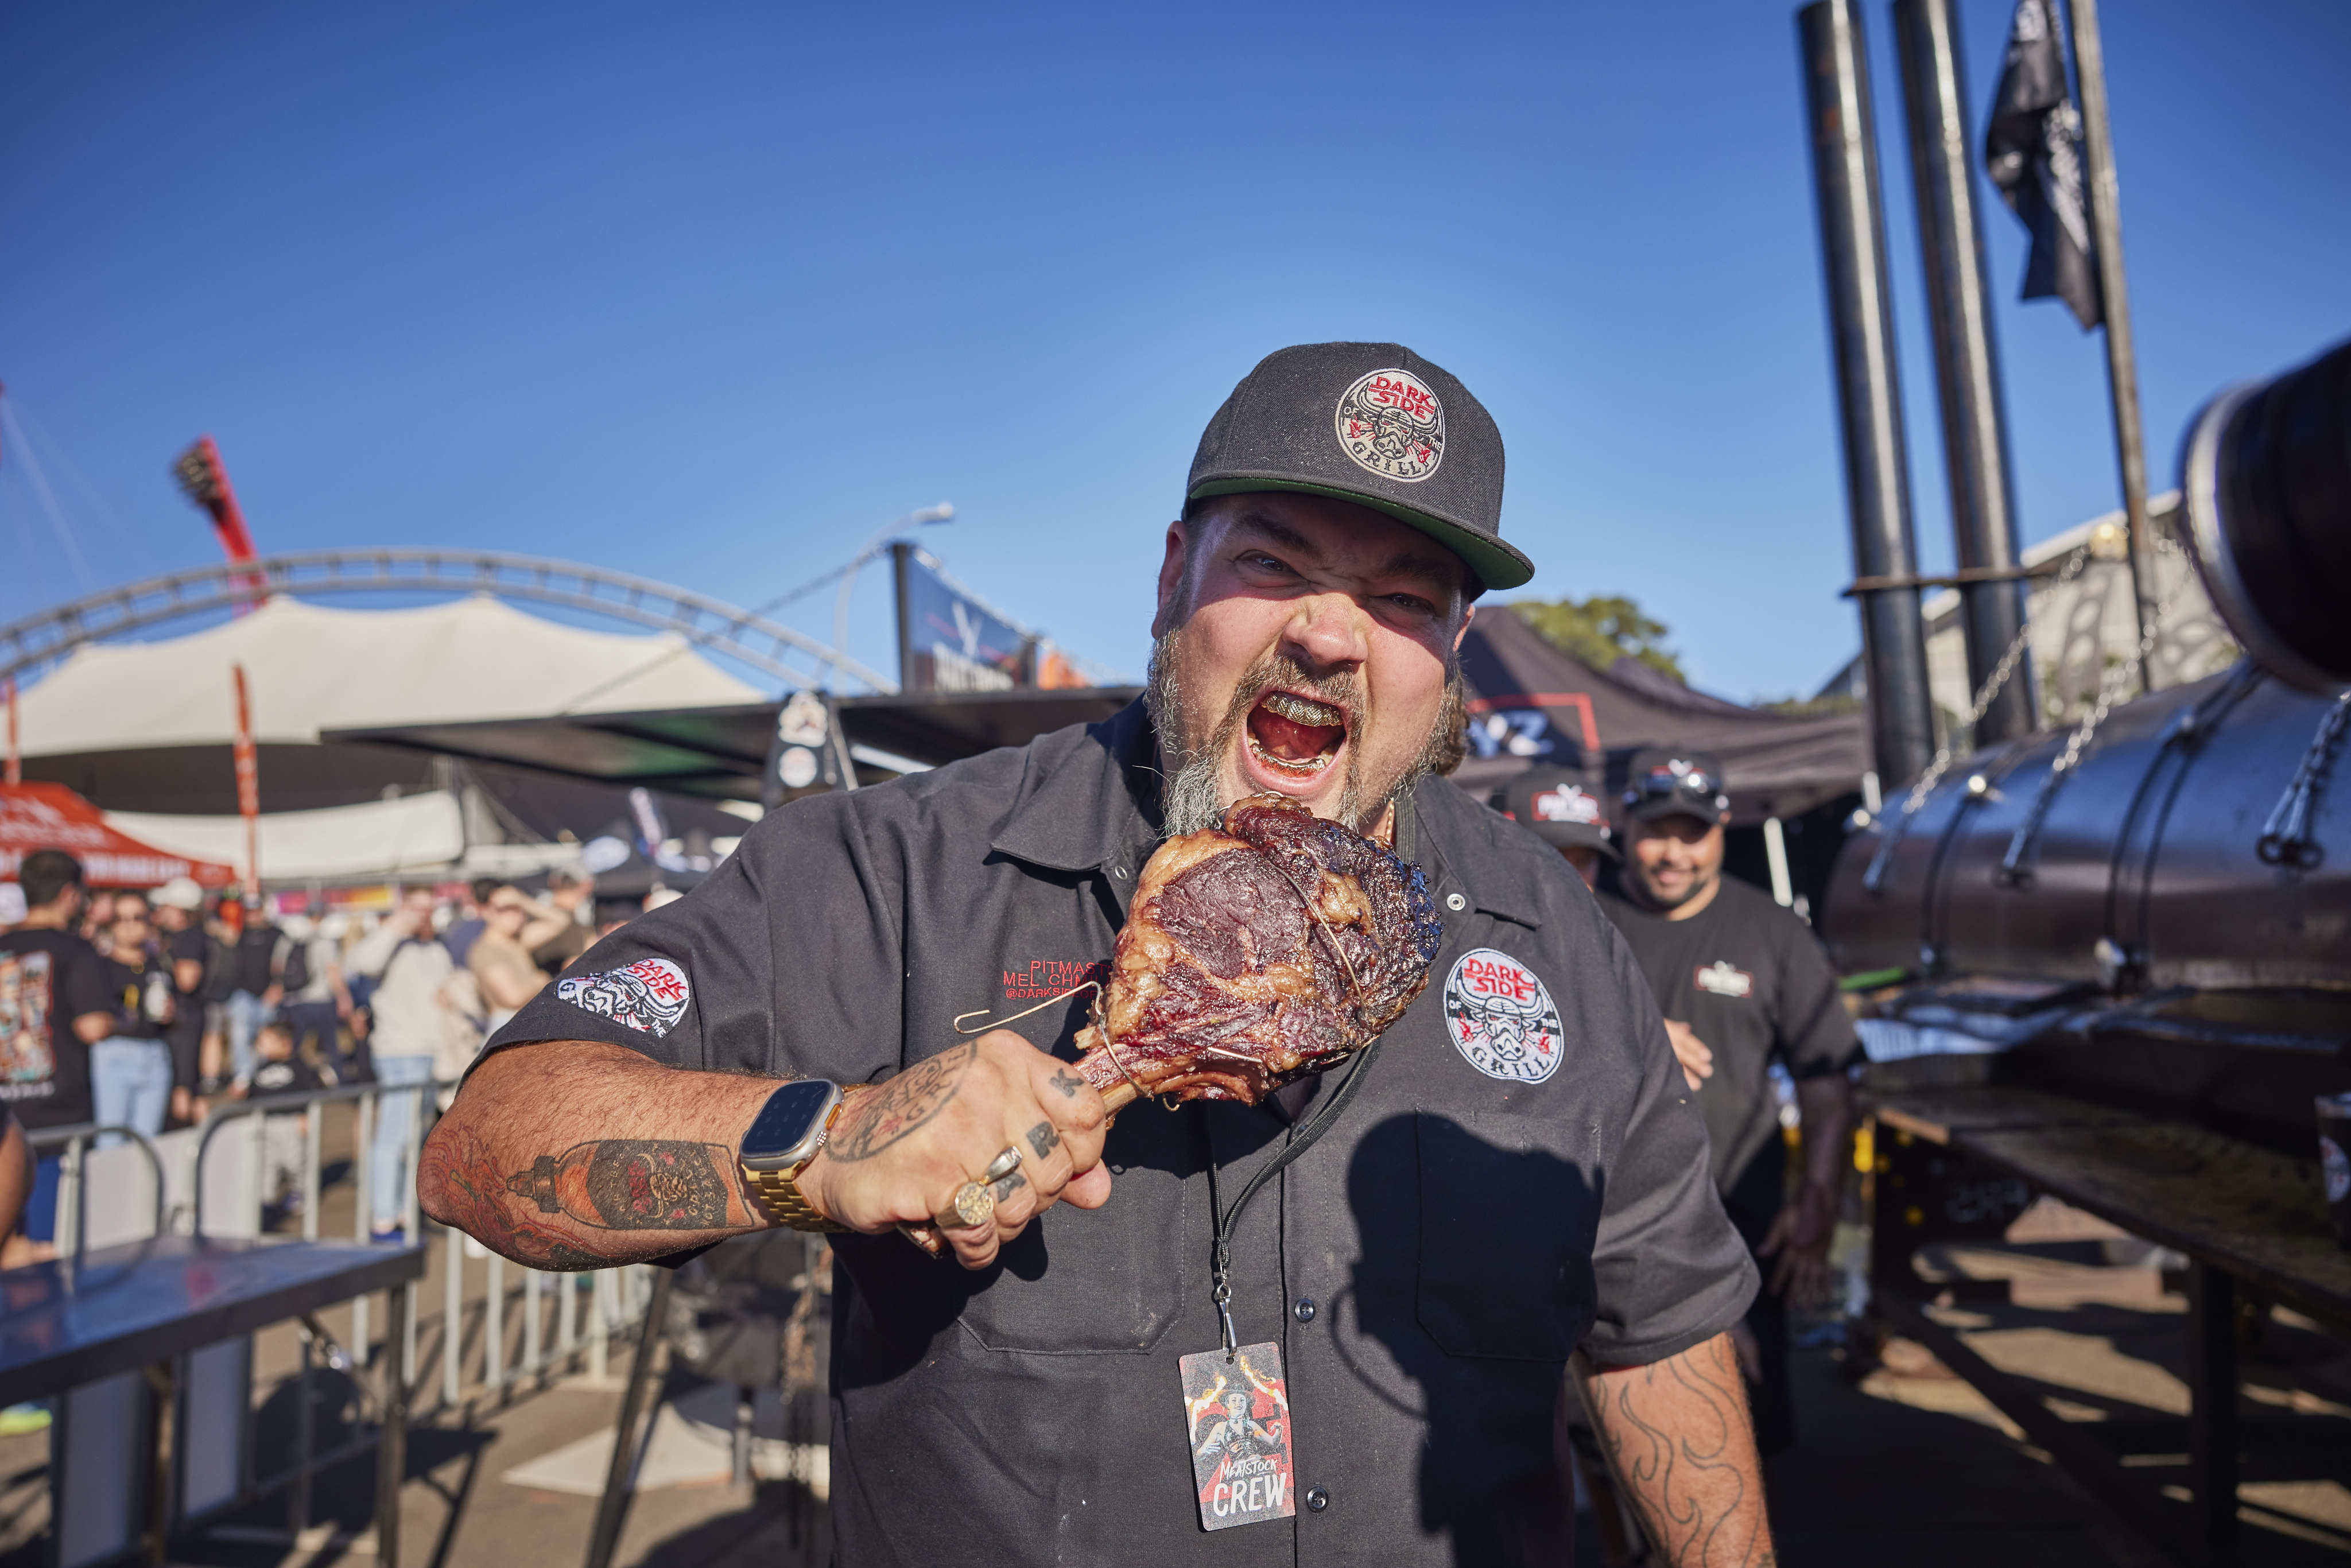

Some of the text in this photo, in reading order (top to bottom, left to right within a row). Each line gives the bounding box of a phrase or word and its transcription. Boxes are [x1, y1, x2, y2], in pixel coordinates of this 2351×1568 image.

[1368, 376, 1435, 414] DARK
[1373, 391, 1426, 420] SIDE
[1344, 406, 1359, 416] OF
[1352, 441, 1421, 475] GRILL
[630, 959, 688, 1001] DARK
[1003, 971, 1039, 987] MEL
[1464, 958, 1536, 992] DARK
[1473, 976, 1528, 1002] SIDE
[1448, 1000, 1462, 1010] OF
[1540, 1018, 1559, 1028] THE
[1472, 1046, 1550, 1077] GRILL
[1213, 1472, 1287, 1517] CREW
